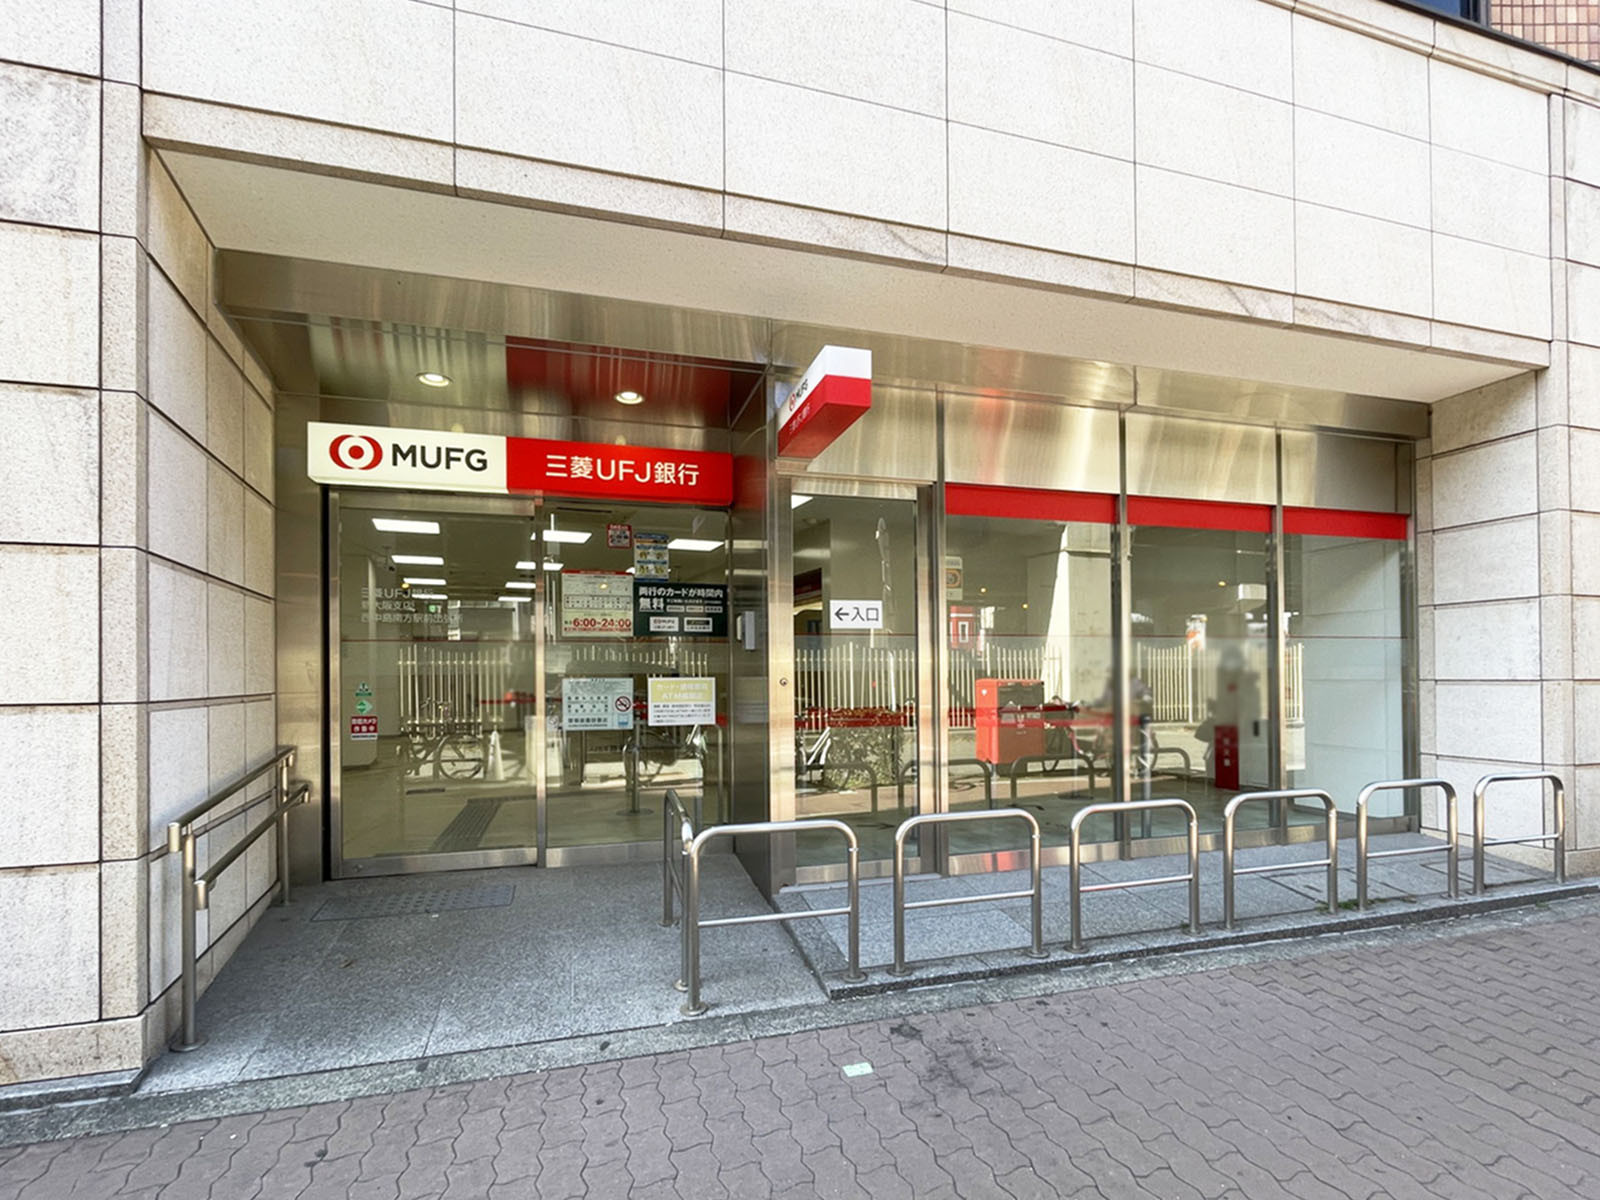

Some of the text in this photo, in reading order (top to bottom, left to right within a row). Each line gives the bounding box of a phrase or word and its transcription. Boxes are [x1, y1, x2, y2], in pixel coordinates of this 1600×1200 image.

[391, 443, 488, 472] MUFG
[545, 454, 700, 486] 三菱UFJ銀行
[639, 597, 664, 611] 無料
[851, 606, 879, 621] 入口
